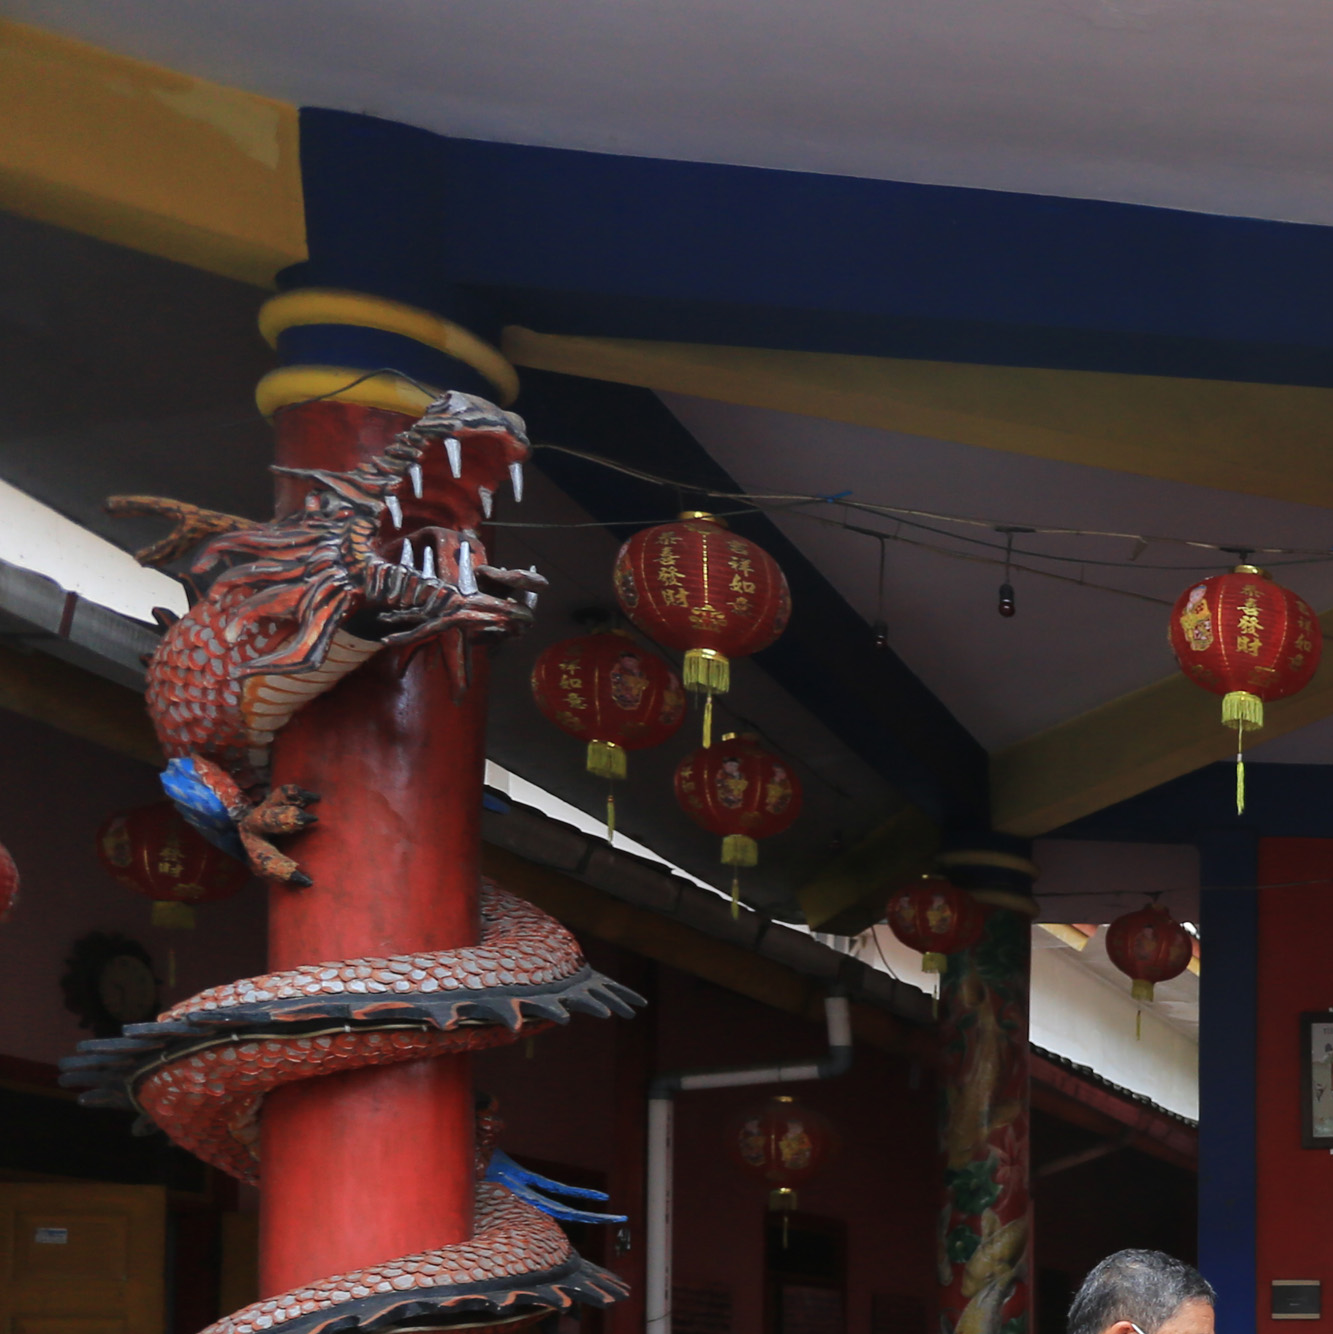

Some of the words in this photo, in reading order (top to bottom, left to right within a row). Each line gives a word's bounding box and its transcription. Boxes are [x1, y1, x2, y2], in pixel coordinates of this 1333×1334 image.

[653, 531, 691, 608] 恭喜發財
[725, 539, 757, 617] 吉祥如意
[1234, 584, 1266, 657] 恭喜發財
